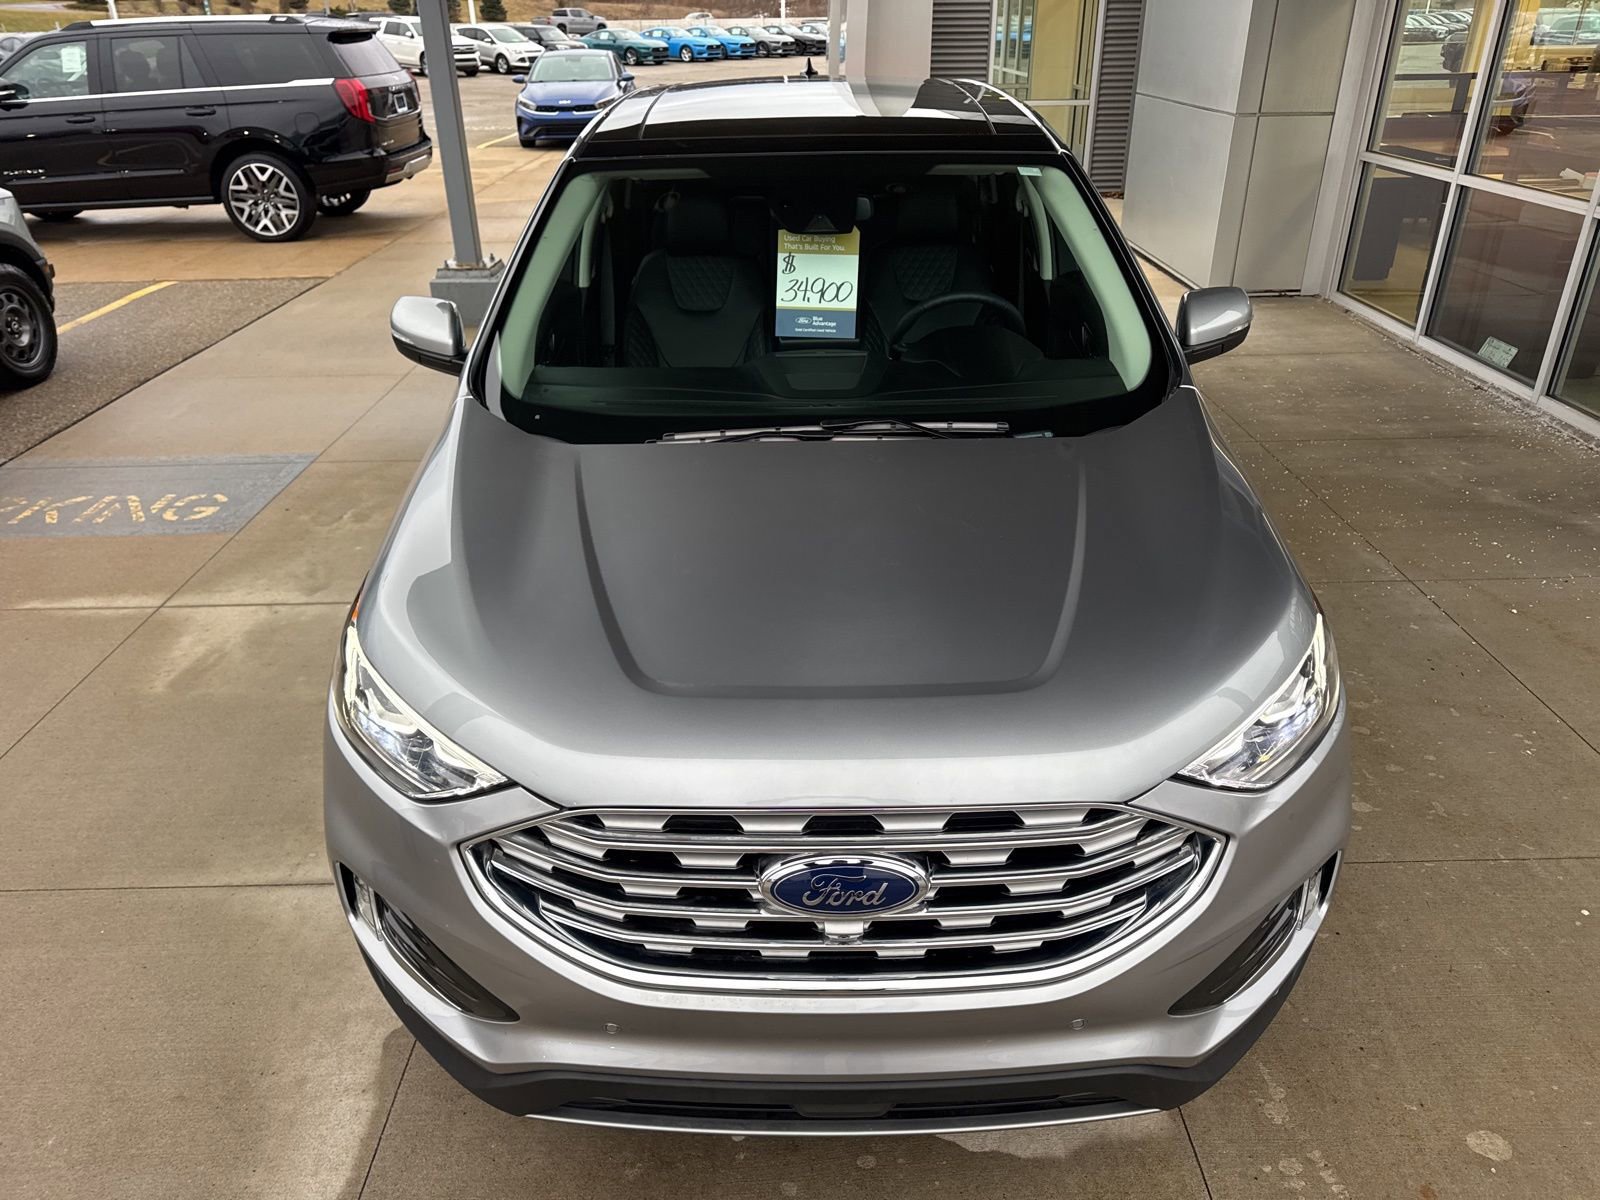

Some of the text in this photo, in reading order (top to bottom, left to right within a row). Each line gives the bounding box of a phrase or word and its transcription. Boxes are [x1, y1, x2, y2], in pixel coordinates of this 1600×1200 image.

[783, 234, 800, 242] Used
[813, 235, 836, 243] Buying
[783, 242, 804, 250] That's
[781, 252, 797, 275] $
[802, 873, 889, 906] Ford
